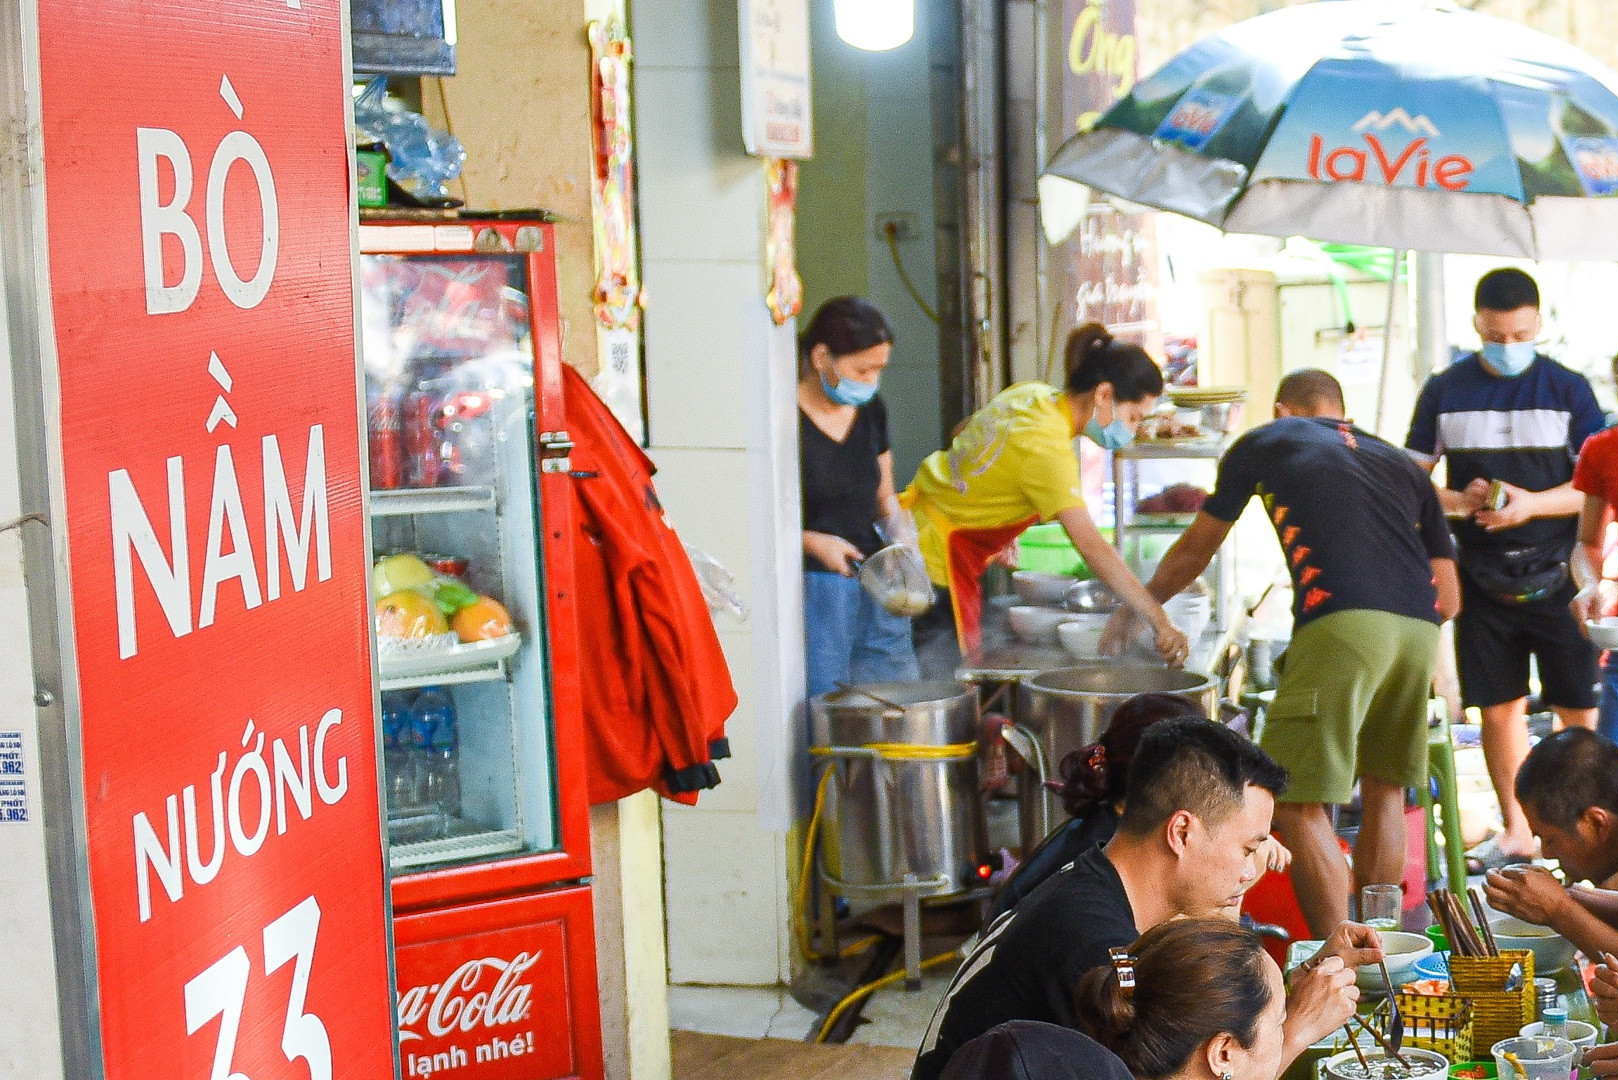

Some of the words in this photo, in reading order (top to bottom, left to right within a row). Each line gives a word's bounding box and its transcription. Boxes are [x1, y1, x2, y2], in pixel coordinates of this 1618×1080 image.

[136, 73, 279, 315] BÒ
[109, 349, 332, 660] NẦM
[132, 707, 348, 923] NƯỚNG
[397, 949, 542, 1043] a-Cola
[408, 1045, 467, 1079] lạnh
